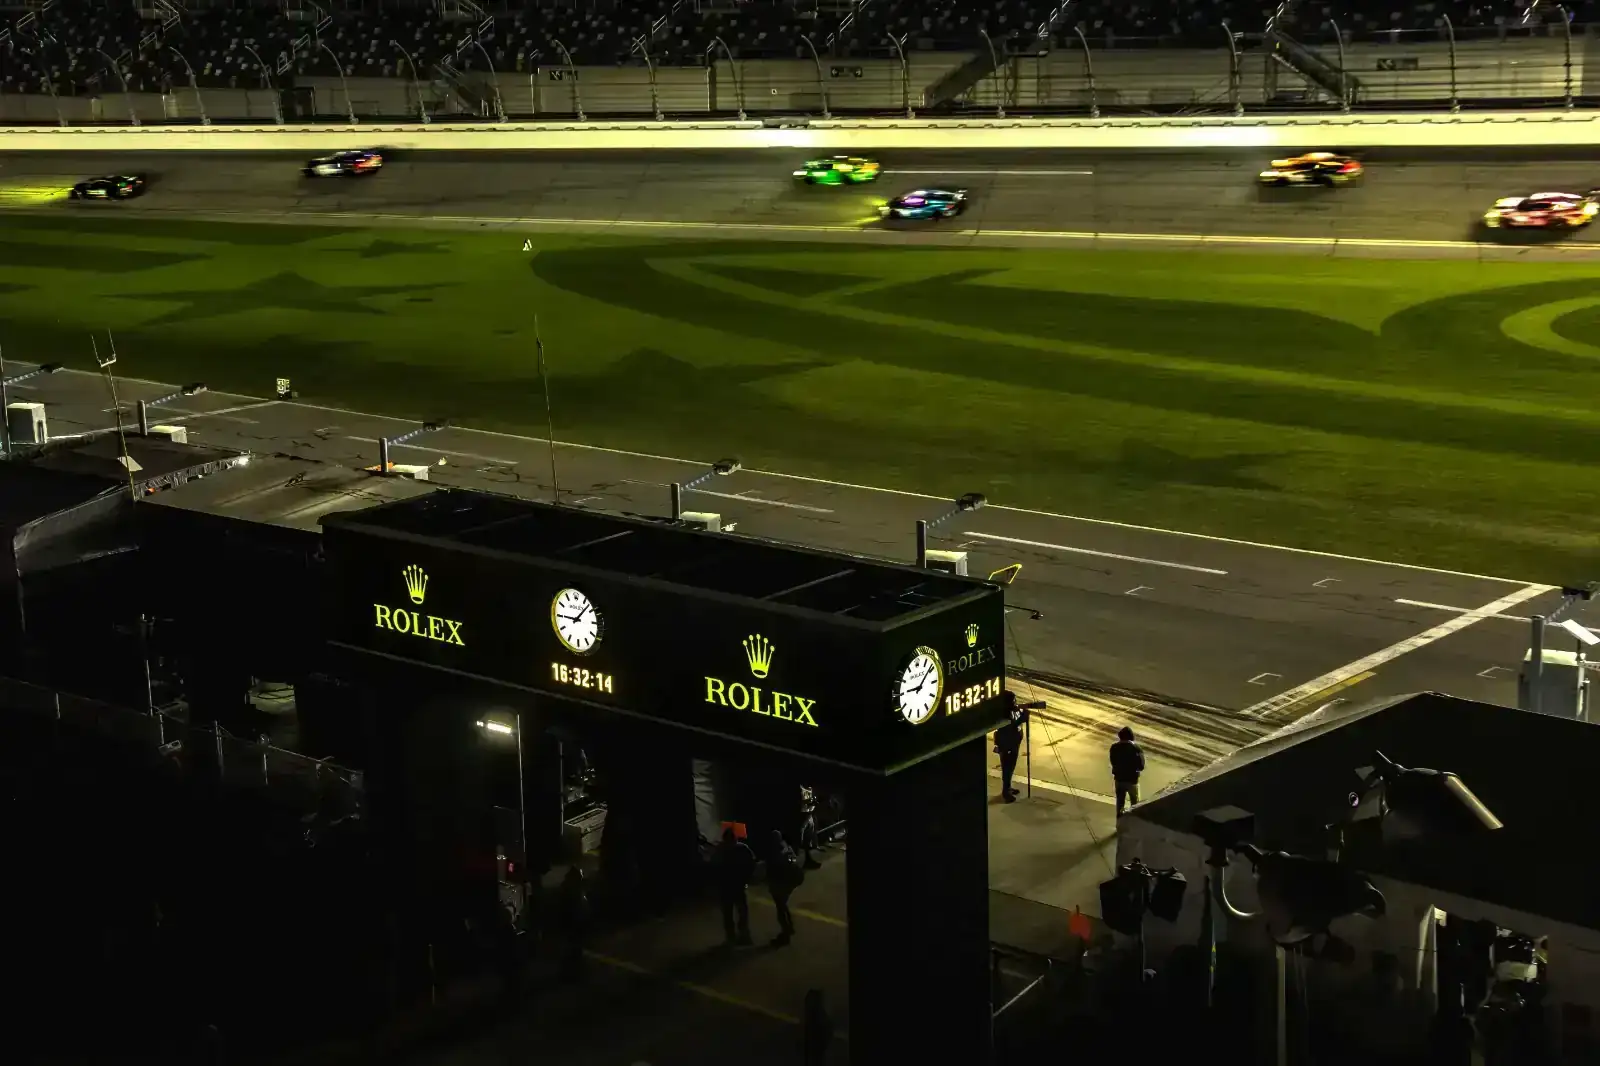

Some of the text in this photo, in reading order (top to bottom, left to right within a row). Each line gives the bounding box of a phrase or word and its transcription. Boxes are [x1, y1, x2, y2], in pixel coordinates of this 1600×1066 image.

[374, 604, 465, 646] ROLEX
[551, 662, 613, 694] 16:32:14
[945, 676, 1000, 716] 16:32:14
[704, 676, 819, 727] ROLEX
